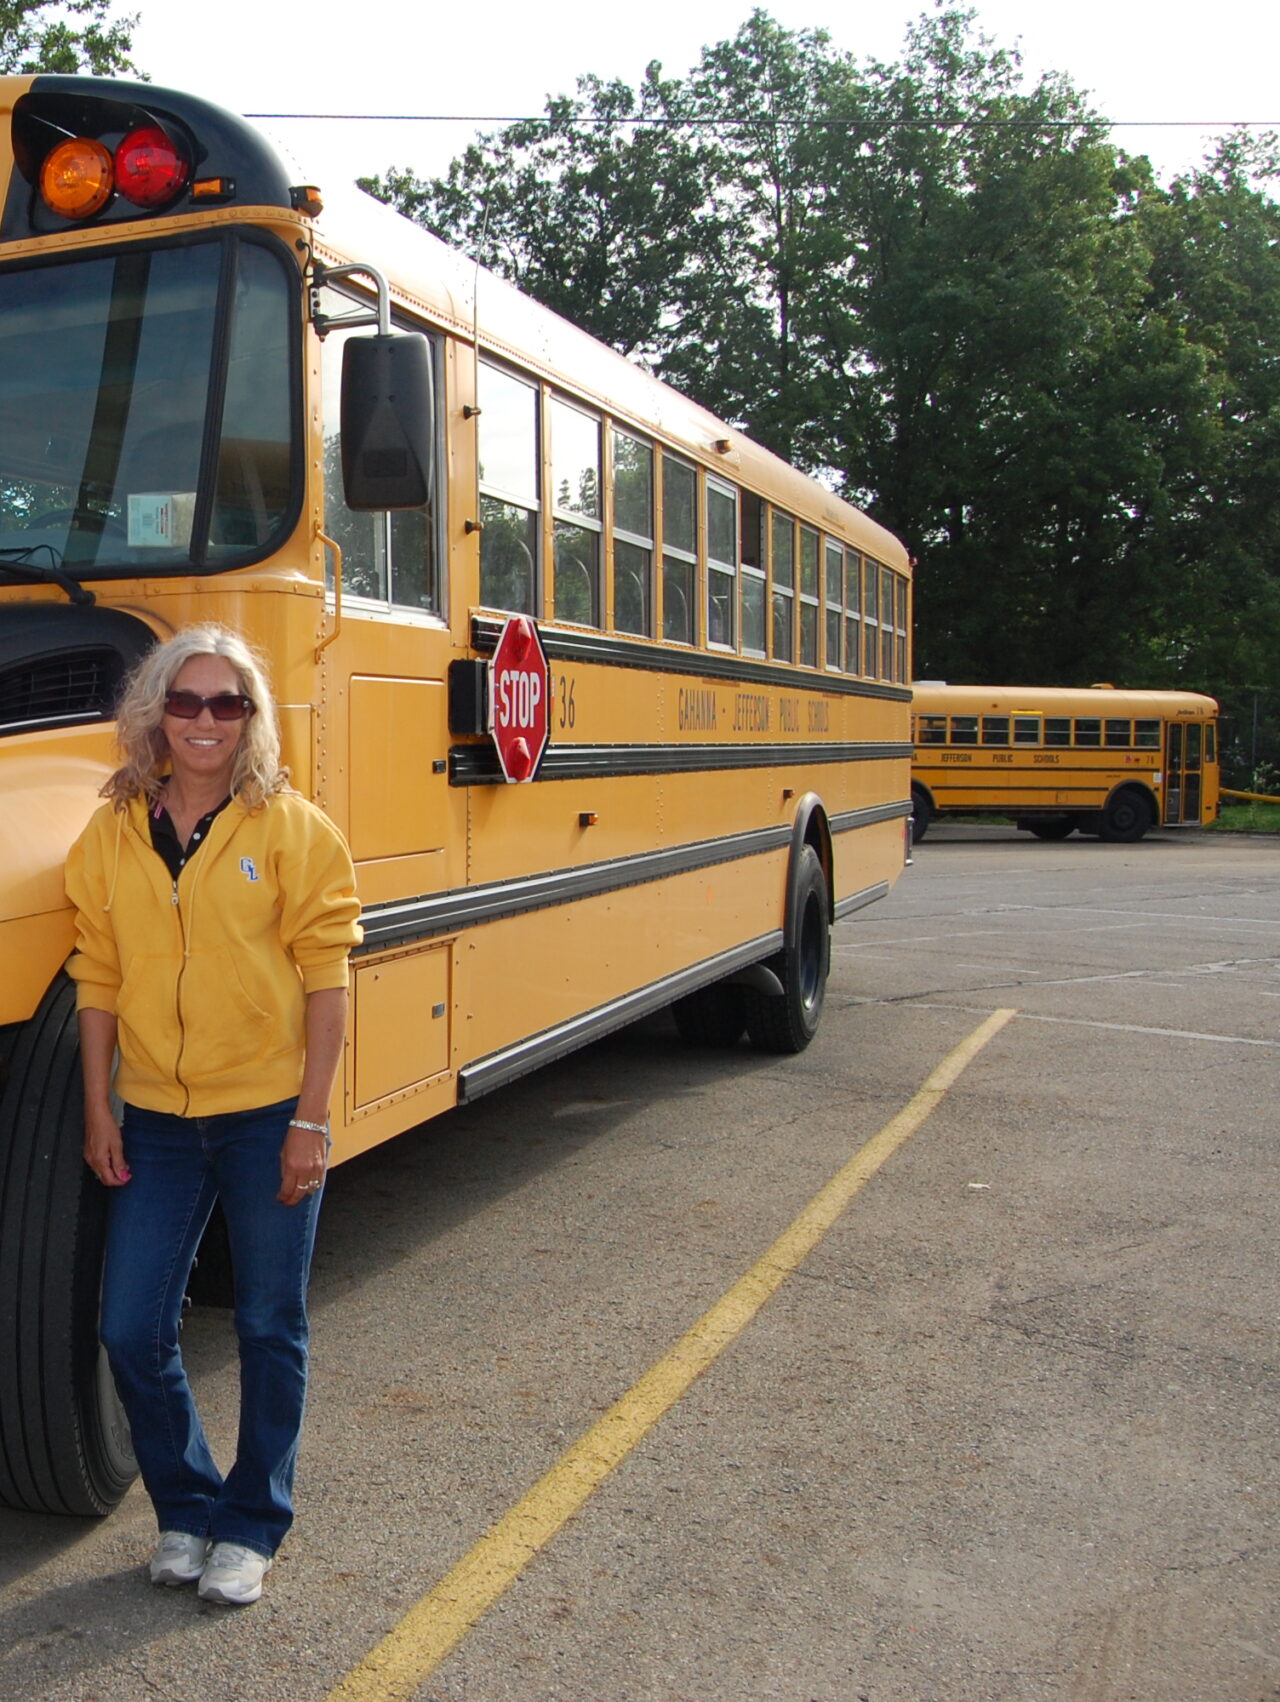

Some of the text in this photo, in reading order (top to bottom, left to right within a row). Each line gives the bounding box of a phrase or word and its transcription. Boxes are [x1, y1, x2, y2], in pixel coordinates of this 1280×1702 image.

[499, 669, 541, 728] STOP
[559, 675, 576, 729] 36
[678, 687, 717, 731] GAHANNA
[732, 693, 769, 732] JEFFERSON
[779, 697, 800, 733] PUBLIC
[808, 700, 829, 733] SCHOOLS
[940, 753, 1060, 764] JEFFERSON PUBLIC SCHOOLS
